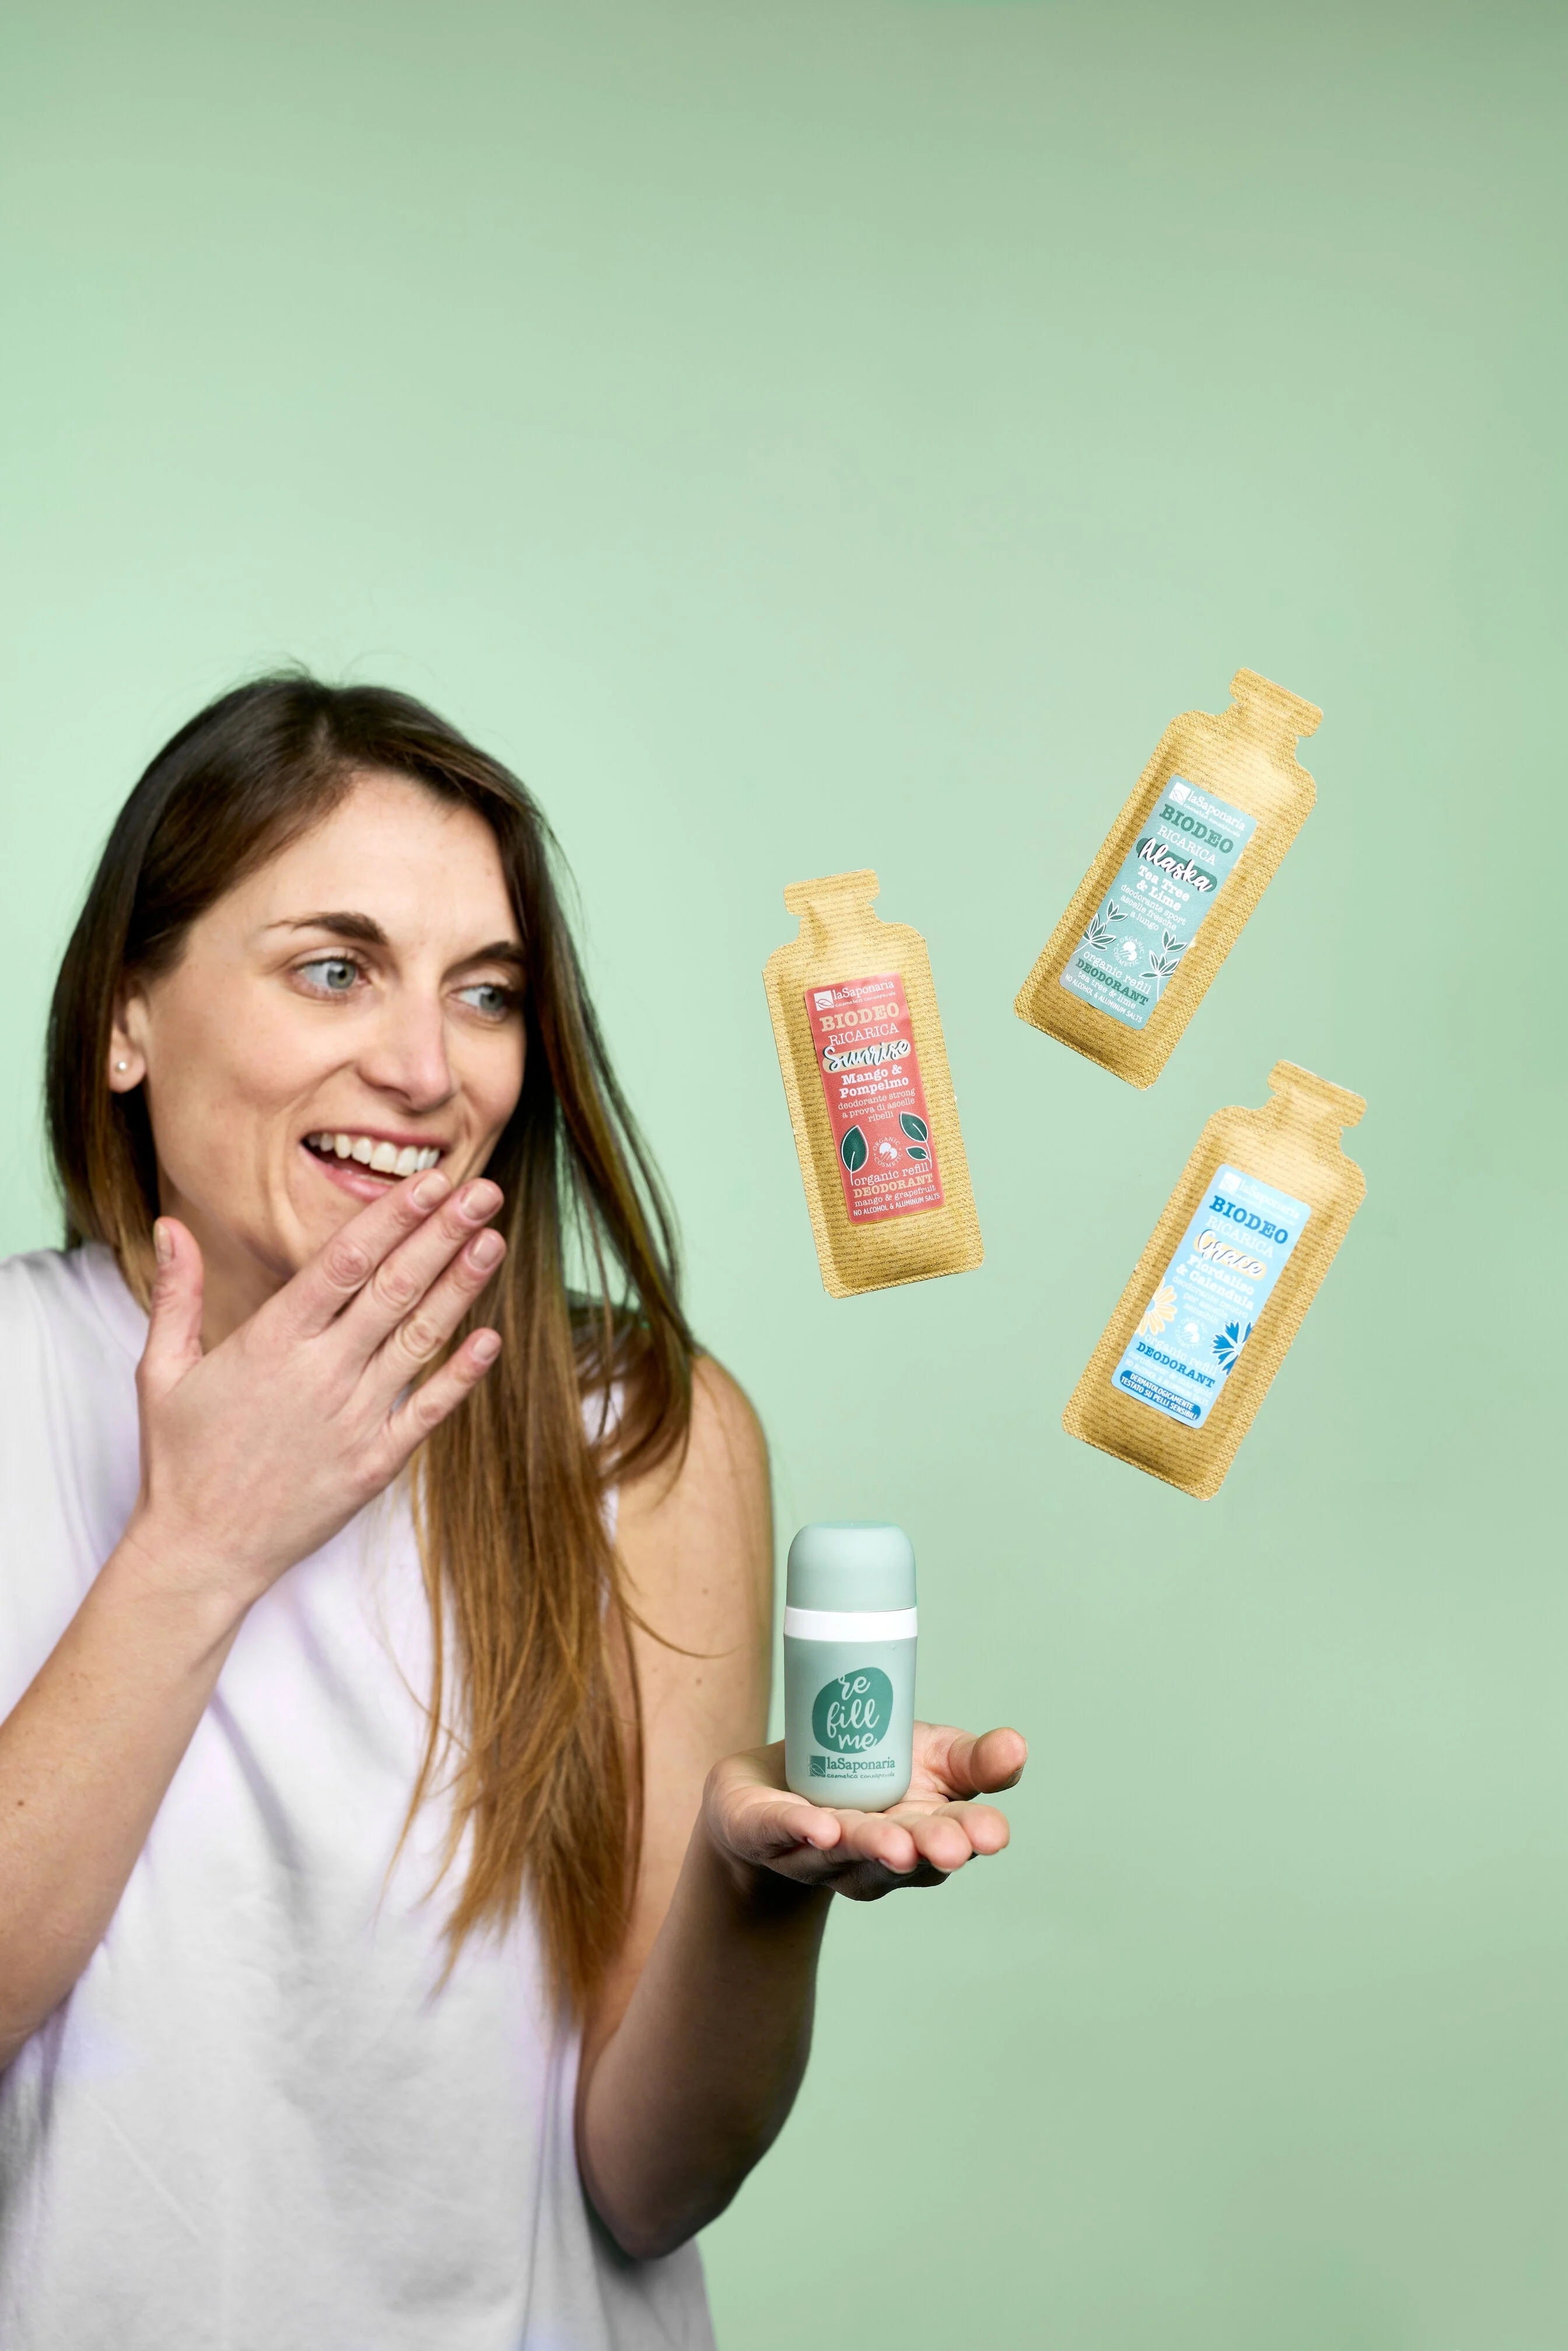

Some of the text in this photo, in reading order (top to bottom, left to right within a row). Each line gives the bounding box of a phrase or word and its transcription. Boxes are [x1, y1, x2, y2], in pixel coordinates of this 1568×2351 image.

[1188, 791, 1245, 831] laSaponaria
[1158, 804, 1234, 853] BIODEO
[1157, 825, 1216, 866] RICARICA
[1138, 837, 1213, 893] Alaska
[1136, 880, 1182, 911] & Lime
[1138, 865, 1190, 902] Tea Tree
[1120, 895, 1177, 930] ascelle fresche
[1121, 884, 1186, 925] deodorante sport
[1136, 912, 1160, 931] lungo
[1113, 947, 1140, 967] COSMETIC
[1119, 936, 1144, 954] ORGANIC
[1076, 958, 1149, 1006] DEODORANT
[1083, 951, 1152, 995] organic refill
[834, 980, 894, 1000] laSaponaria
[835, 992, 896, 1007] cosmetica consapevole
[1065, 974, 1073, 983] NO
[1072, 979, 1093, 997] ALCOHOL
[1098, 995, 1126, 1014] ALUMINUM
[1126, 1010, 1142, 1023] SALTS
[1078, 971, 1090, 982] tea
[1091, 979, 1108, 993] tree
[1117, 993, 1136, 1009] lime
[819, 1002, 900, 1032] BIODEO
[828, 1023, 900, 1047] RICARICA
[822, 1041, 908, 1071] Sunrise
[839, 1077, 909, 1098] Pompelmo
[841, 1064, 902, 1085] Mango &
[838, 1088, 916, 1110] deodorante strong
[849, 1106, 875, 1119] prova
[877, 1103, 886, 1111] di
[887, 1098, 915, 1109] ascelle
[868, 1111, 894, 1122] ribelli
[873, 1136, 901, 1152] ORGANIC
[854, 1162, 929, 1187] organic refill
[874, 1152, 903, 1168] COSMETIC
[853, 1174, 933, 1198] DEODORANT
[854, 1197, 883, 1208] mango
[895, 1185, 936, 1200] grapefruit
[863, 1204, 888, 1215] ALCOHOL
[895, 1198, 924, 1208] ALUMINUM
[925, 1192, 940, 1202] SALTS
[1209, 1195, 1289, 1245] BIODEO
[1205, 1215, 1273, 1258] RICARICA
[1198, 1229, 1263, 1276] Grace
[1176, 1264, 1254, 1310] & Calendula
[1186, 1254, 1254, 1295] Fiordaliso
[1136, 1342, 1216, 1388] DEODORANT
[1144, 1335, 1218, 1377] organic refill
[1121, 1377, 1143, 1392] TESTATO
[1153, 1394, 1169, 1406] PELLI
[1170, 1404, 1196, 1420] SENSIBILI
[1130, 1373, 1194, 1410] DERMATOLOGICAMENTE
[838, 1674, 870, 1700] re
[827, 1699, 880, 1738] fill
[839, 1733, 877, 1750] me
[827, 1757, 895, 1773] laSaponaria
